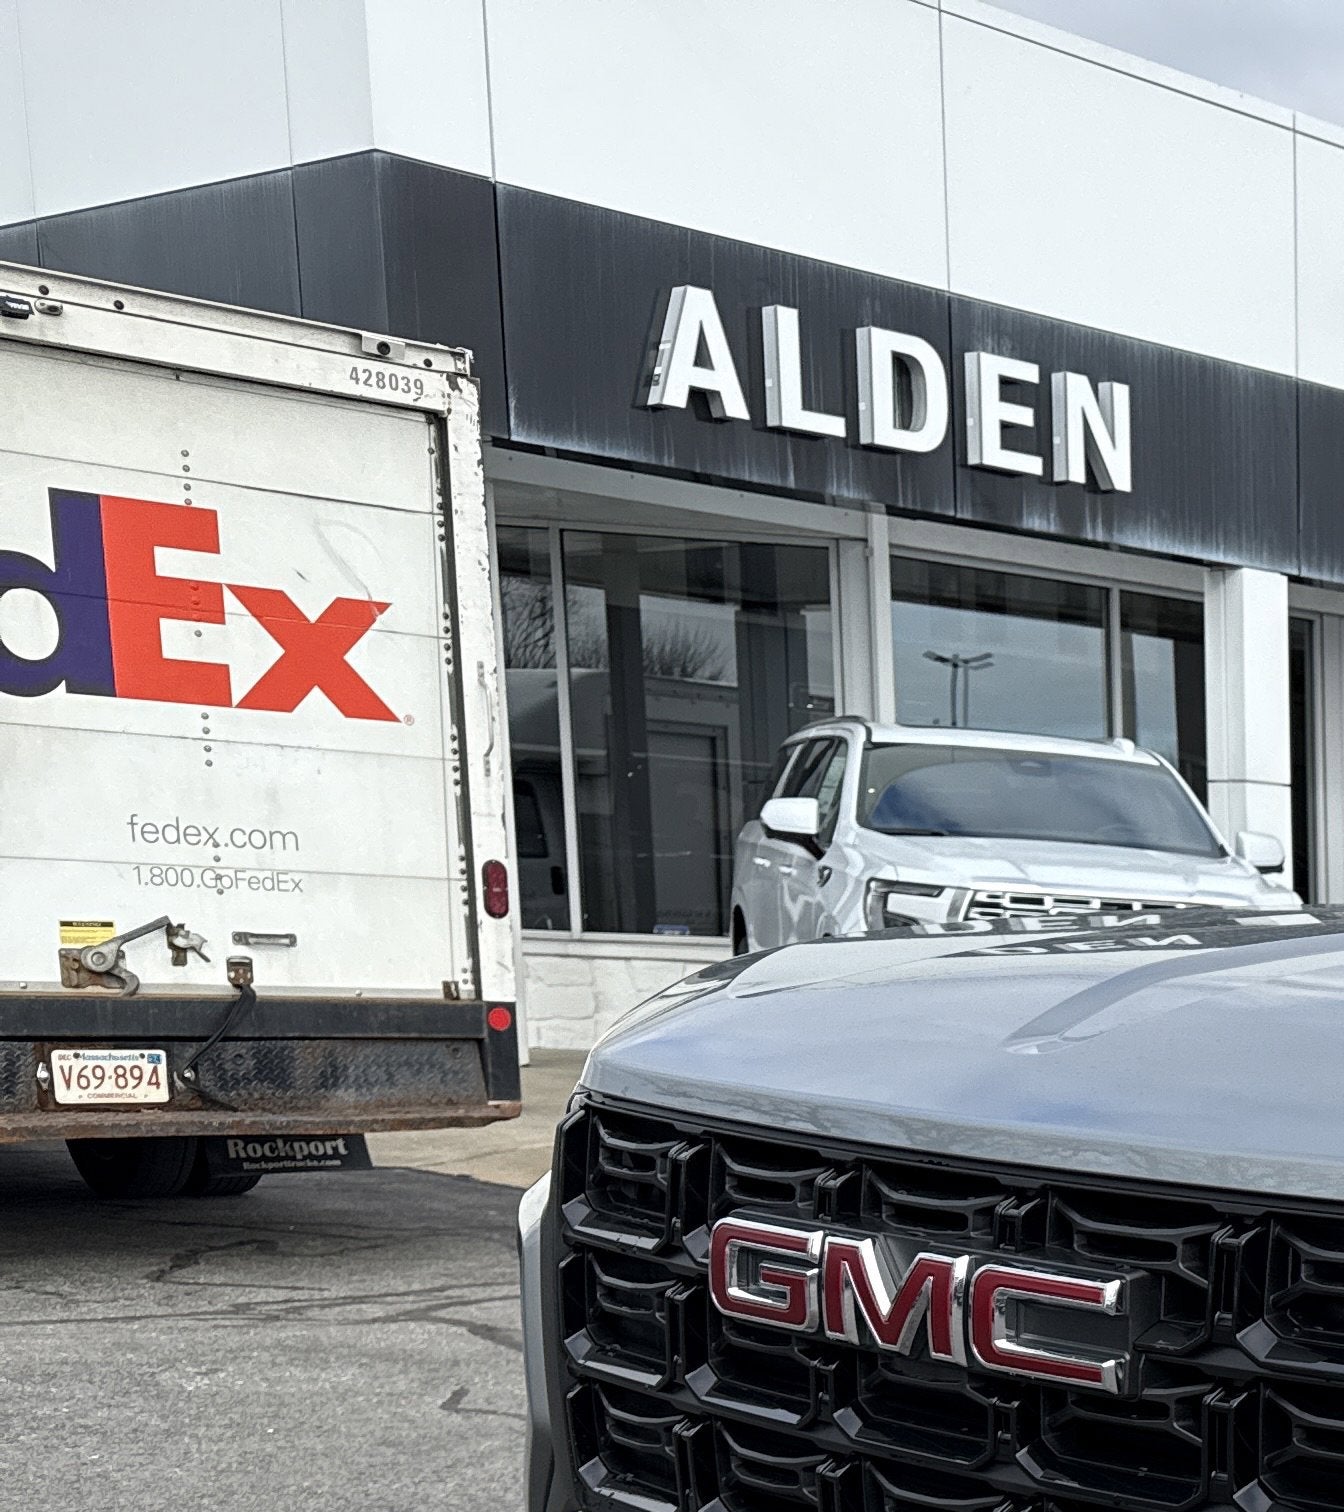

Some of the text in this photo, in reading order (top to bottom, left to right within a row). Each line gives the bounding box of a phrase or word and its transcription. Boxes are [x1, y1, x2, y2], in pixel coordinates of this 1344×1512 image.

[349, 366, 424, 396] 428039
[647, 284, 1132, 493] ALDEN
[126, 813, 300, 851] fedex.com
[132, 865, 304, 893] 1.800.GoFedEx
[227, 1137, 349, 1160] Rockport
[707, 1216, 1129, 1395] GMC
